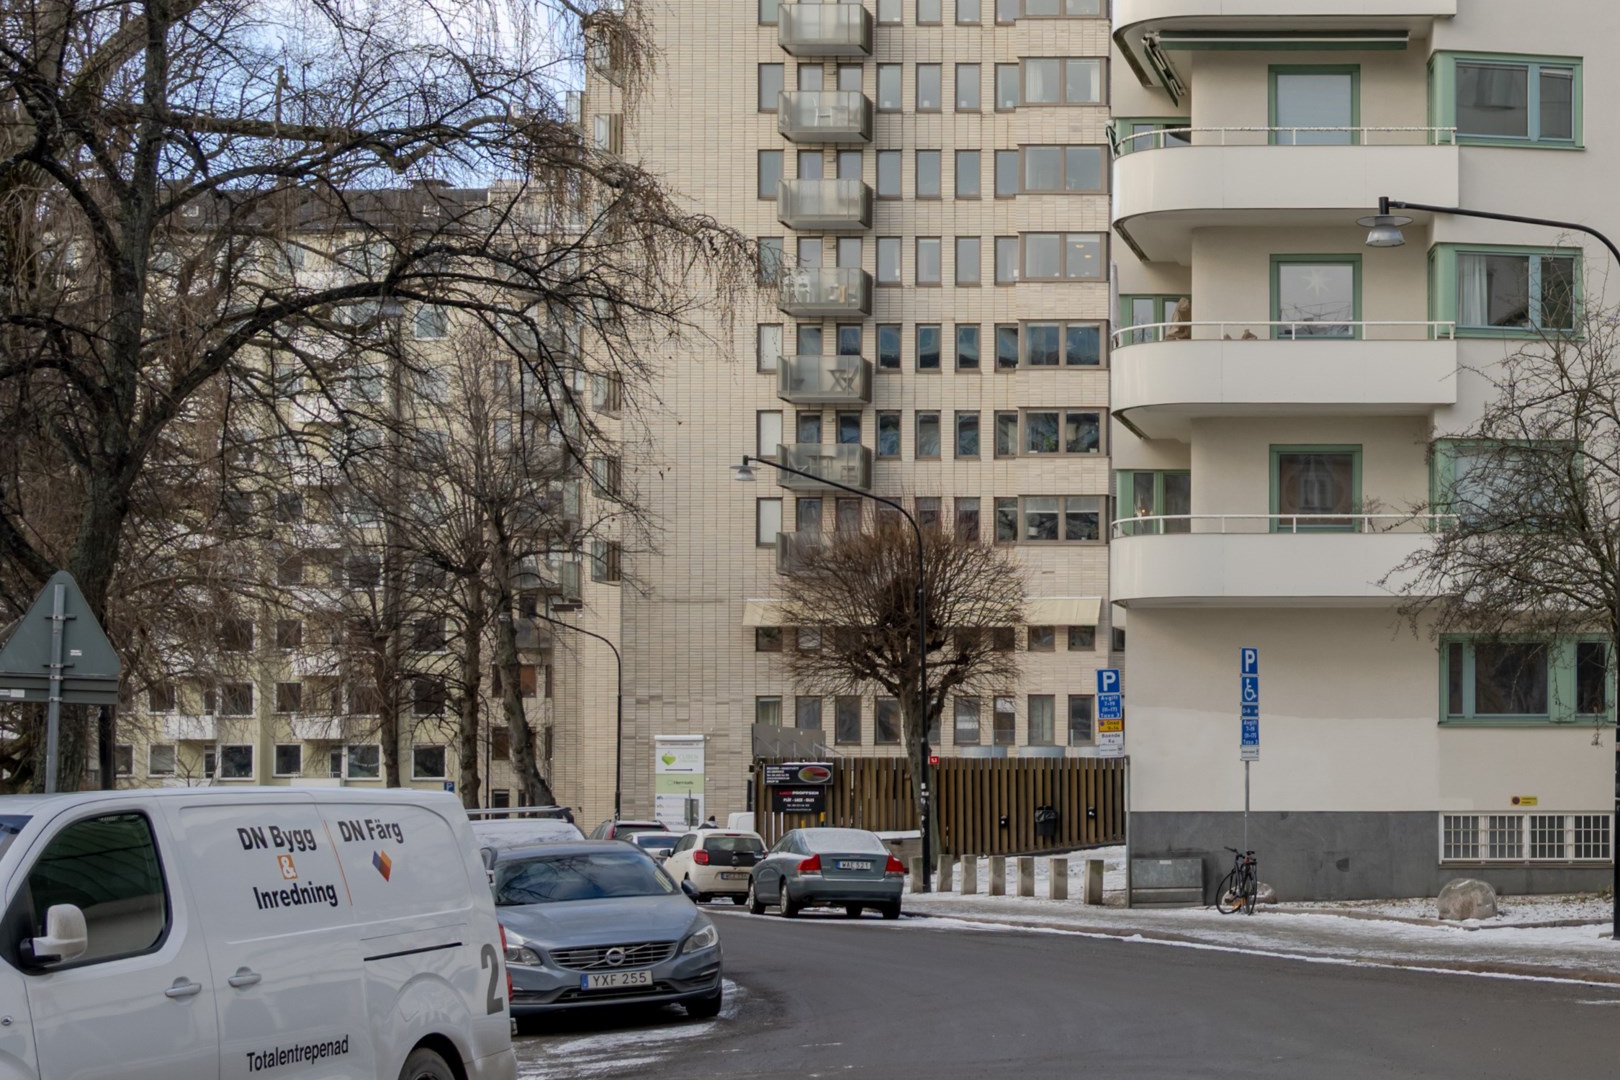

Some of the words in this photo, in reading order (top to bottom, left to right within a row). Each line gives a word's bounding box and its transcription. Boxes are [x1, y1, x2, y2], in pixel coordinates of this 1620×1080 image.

[1245, 650, 1255, 672] P
[1103, 671, 1116, 692] P
[446, 782, 453, 791] P
[237, 826, 268, 850] DN
[268, 825, 317, 853] Bygg
[337, 819, 366, 842] DN
[365, 818, 404, 844] Färg
[281, 856, 296, 879] &
[253, 881, 338, 910] Inredning
[481, 943, 504, 1015] 2
[593, 974, 617, 987] YXF
[622, 972, 647, 985] 255
[247, 1034, 349, 1072] Totalentrepenad
